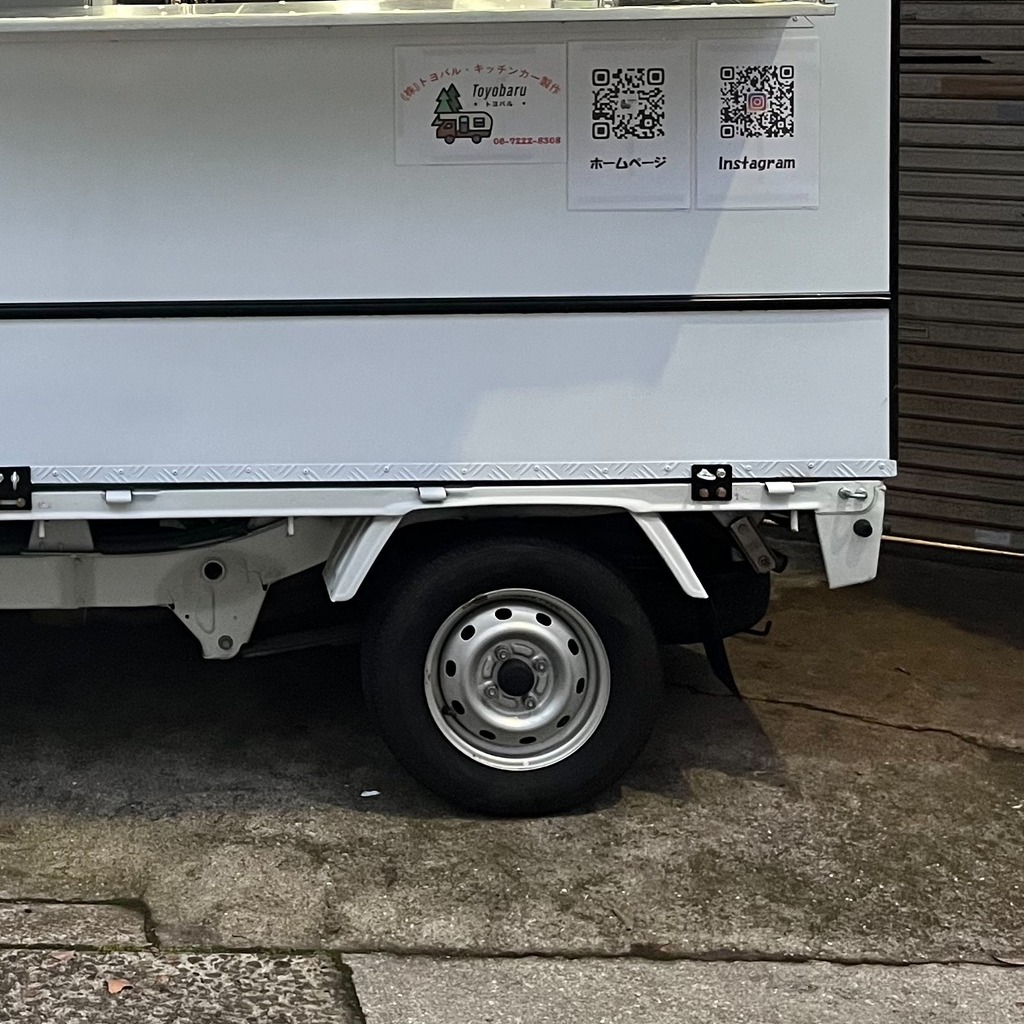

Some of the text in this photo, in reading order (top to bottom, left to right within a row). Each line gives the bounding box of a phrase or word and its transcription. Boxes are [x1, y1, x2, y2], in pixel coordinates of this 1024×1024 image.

[472, 83, 527, 100] Toyobaru
[590, 156, 667, 170] ホームページ
[718, 156, 796, 171] Instagram
